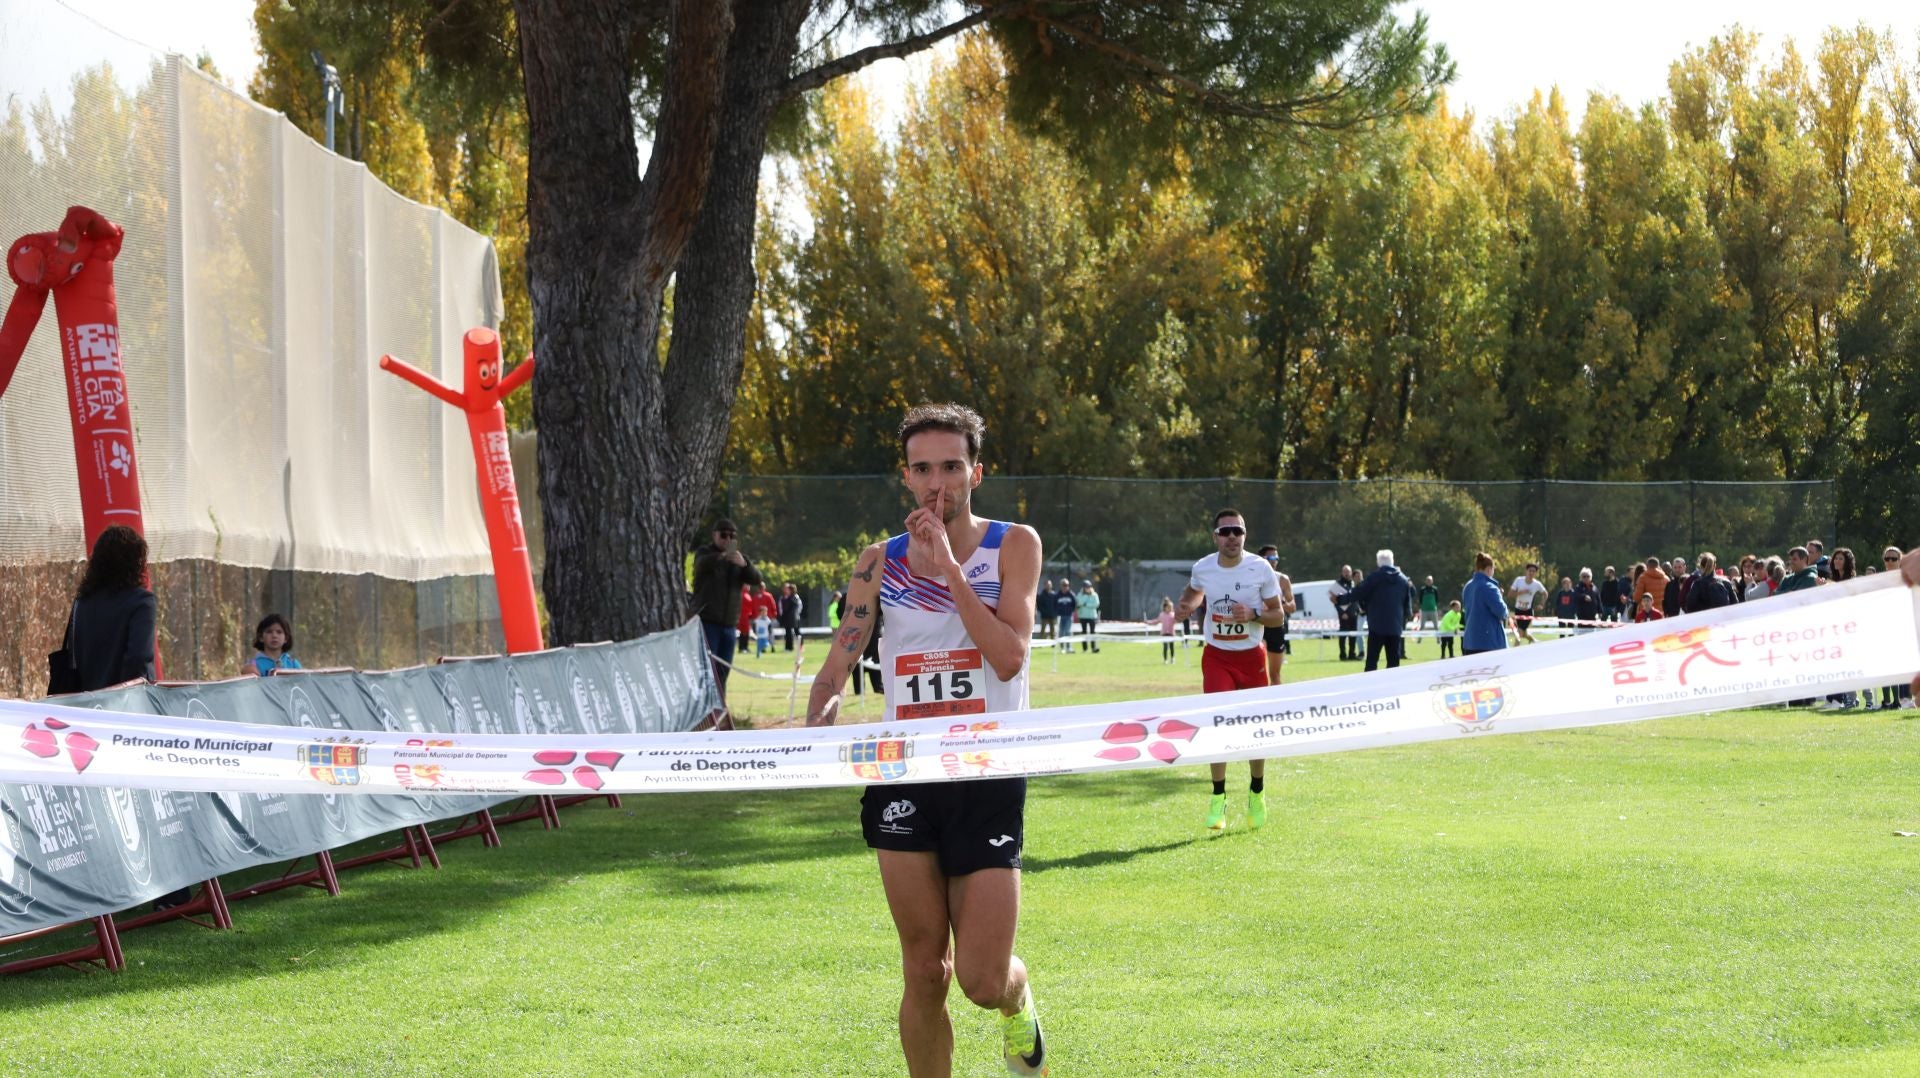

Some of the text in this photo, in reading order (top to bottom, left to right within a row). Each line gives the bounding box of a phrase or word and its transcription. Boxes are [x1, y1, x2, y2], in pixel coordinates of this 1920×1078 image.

[65, 327, 87, 425] AYUNTAMIENTO
[84, 376, 101, 418] CIA
[97, 376, 117, 421] LEN
[111, 376, 125, 406] PA
[1216, 623, 1245, 635] 170
[923, 651, 950, 660] CROSS
[1608, 640, 1649, 686] PMD
[920, 663, 955, 673] Palencia
[906, 671, 974, 703] 115
[1615, 668, 1866, 705] Patronato Municipal de Deportes
[1213, 697, 1401, 728] Patronato Municipal
[1252, 719, 1368, 739] de Deportes
[111, 733, 273, 754] Patronato Municipal
[939, 739, 976, 748] Patronato
[977, 735, 1015, 745] Municipal
[1026, 733, 1062, 743] Deportes
[145, 752, 241, 768] de Deportes
[393, 751, 428, 759] Patronato
[429, 750, 464, 760] Municipal
[475, 752, 508, 760] Deportes
[670, 758, 778, 773] de Deportes
[643, 772, 821, 784] Ayuntamiento de Palencia
[43, 785, 58, 803] PA
[48, 801, 74, 826] LEN
[57, 825, 79, 850] CIA
